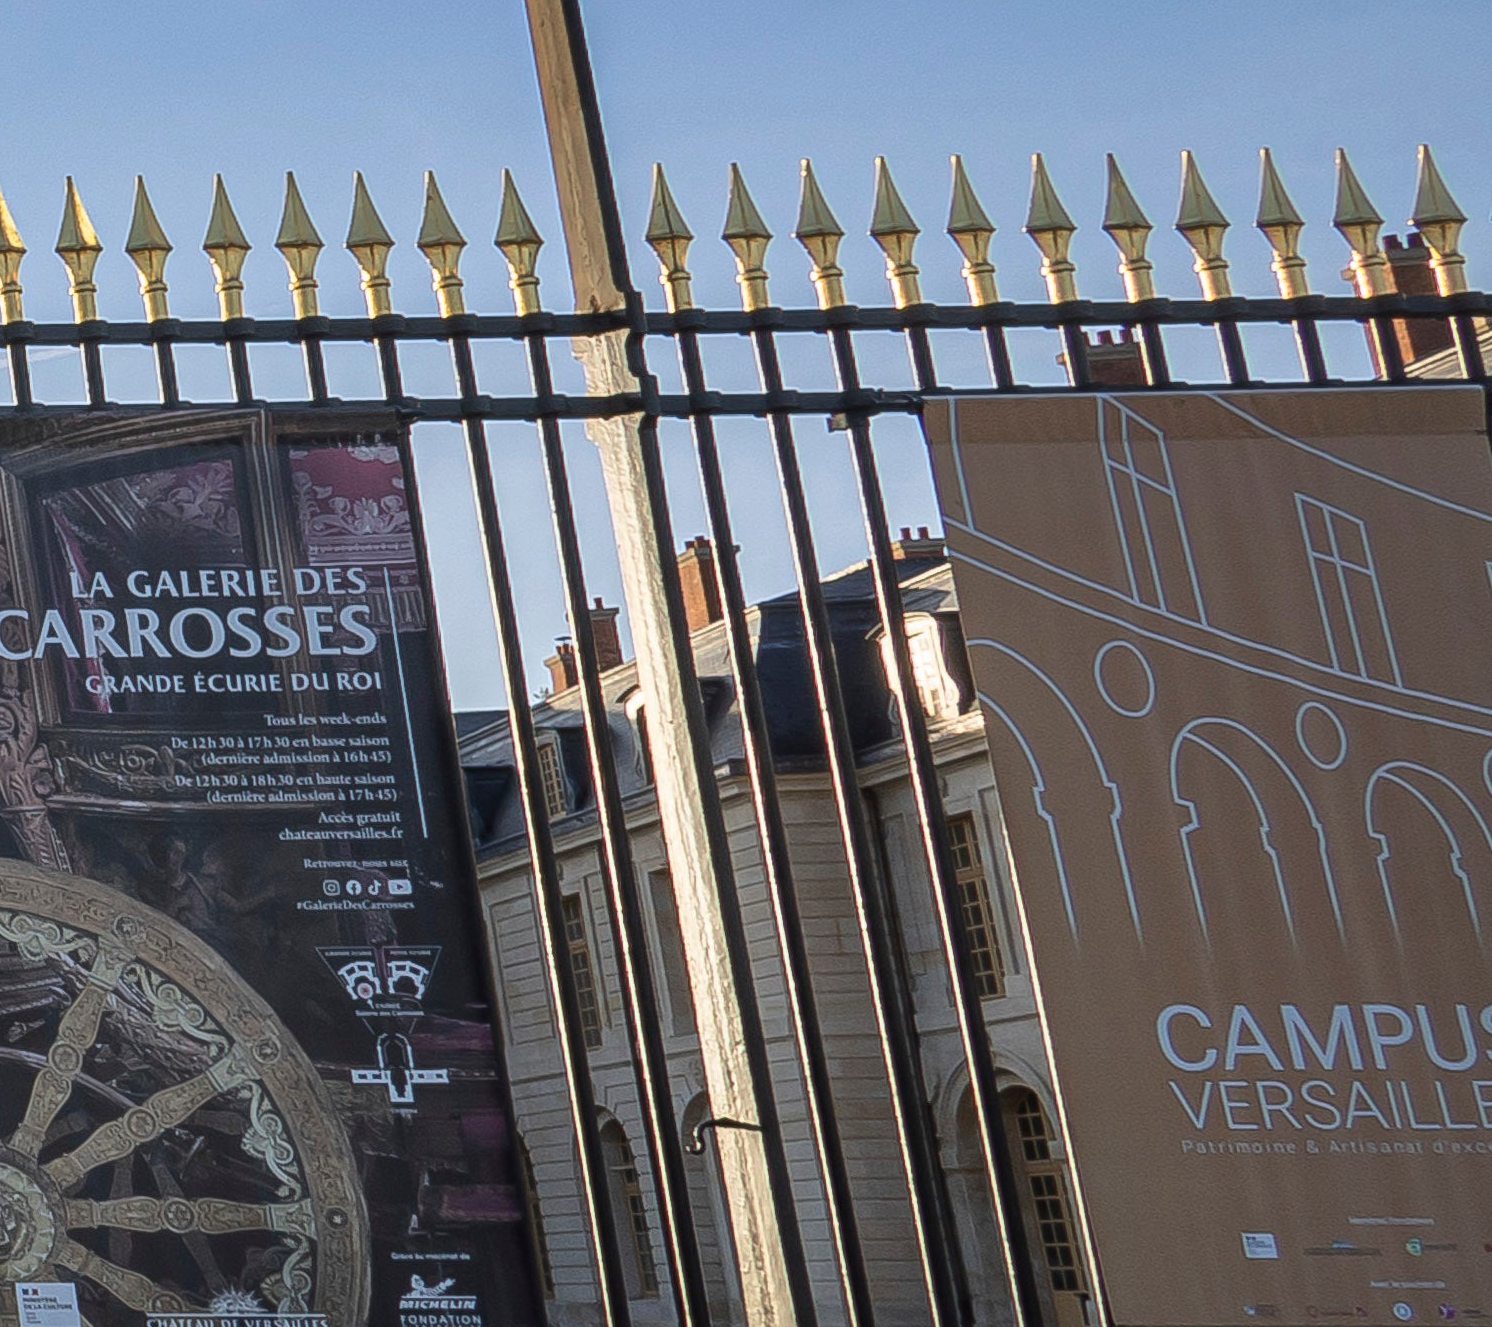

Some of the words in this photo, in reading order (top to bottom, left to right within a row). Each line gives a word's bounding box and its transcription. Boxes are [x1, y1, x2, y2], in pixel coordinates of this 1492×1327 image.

[69, 571, 115, 599] LA
[127, 568, 283, 598] GALERIE
[294, 566, 368, 595] DES
[85, 674, 185, 694] GRANDE
[195, 670, 283, 693] ÉCURIE
[291, 673, 330, 692] DU
[337, 672, 383, 691] ROI
[264, 714, 296, 727] Tous
[298, 713, 318, 726] les
[171, 736, 189, 749] De
[292, 737, 310, 748] en
[311, 734, 346, 747] basse
[348, 734, 390, 746] saison
[263, 751, 330, 764] admission
[174, 774, 194, 787] De
[296, 775, 314, 786] en
[316, 772, 352, 785] haute
[354, 772, 396, 785] saison
[268, 789, 335, 802] admission
[318, 811, 355, 824] Accès
[356, 811, 401, 827] gratuit
[278, 826, 403, 841] chateauversailles.fr
[1156, 1004, 1492, 1071] CAMPU
[1181, 1138, 1296, 1154] Patrimoine
[1306, 1139, 1320, 1154] &
[1329, 1138, 1423, 1154] Artisanat
[1432, 1138, 1492, 1154] d'exc
[399, 1300, 477, 1309] MICHELIN
[400, 1315, 481, 1325] FONDATION
